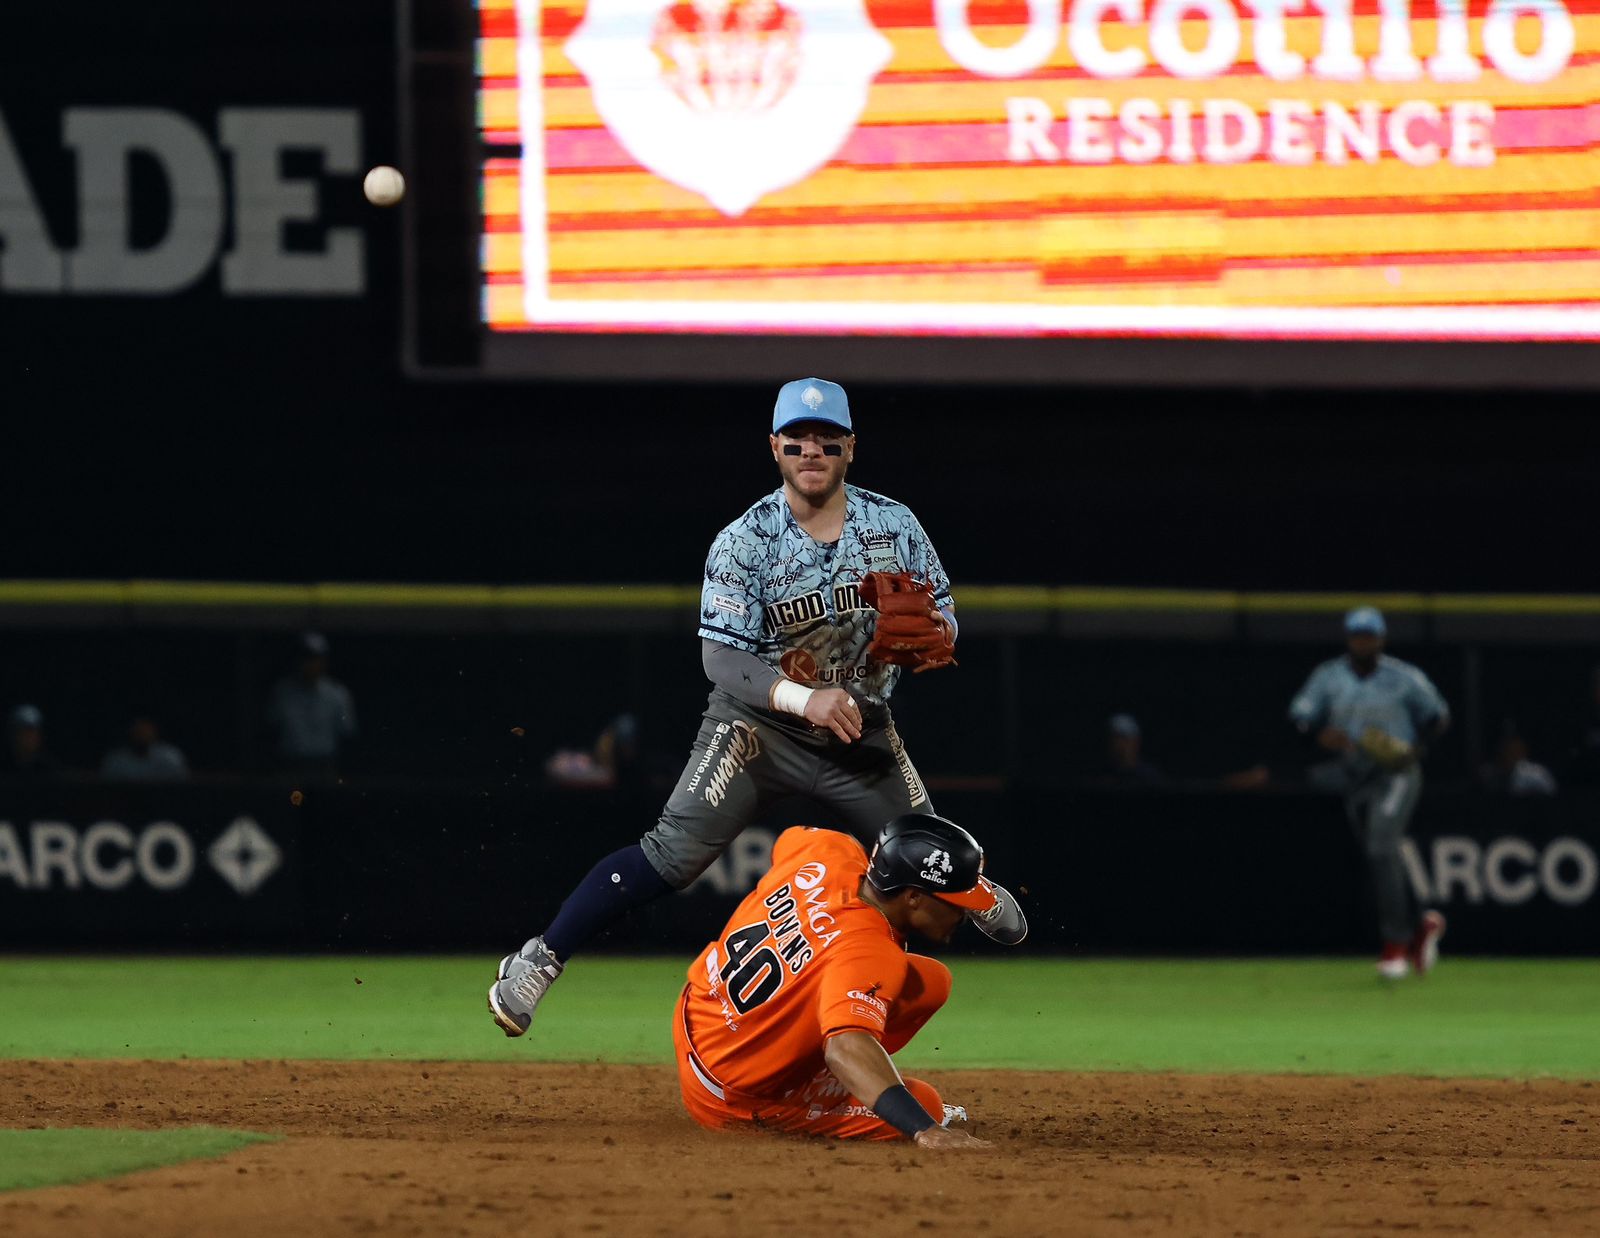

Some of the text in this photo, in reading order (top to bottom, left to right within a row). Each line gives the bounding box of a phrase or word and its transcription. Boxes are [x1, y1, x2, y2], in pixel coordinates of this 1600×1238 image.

[1003, 96, 1497, 167] RESIDENCE
[686, 733, 722, 793] caliente.mx
[705, 720, 760, 807] Caliente
[920, 870, 948, 885] Gallos
[930, 867, 942, 876] Los
[764, 882, 814, 975] BONNS
[719, 920, 784, 1016] 40
